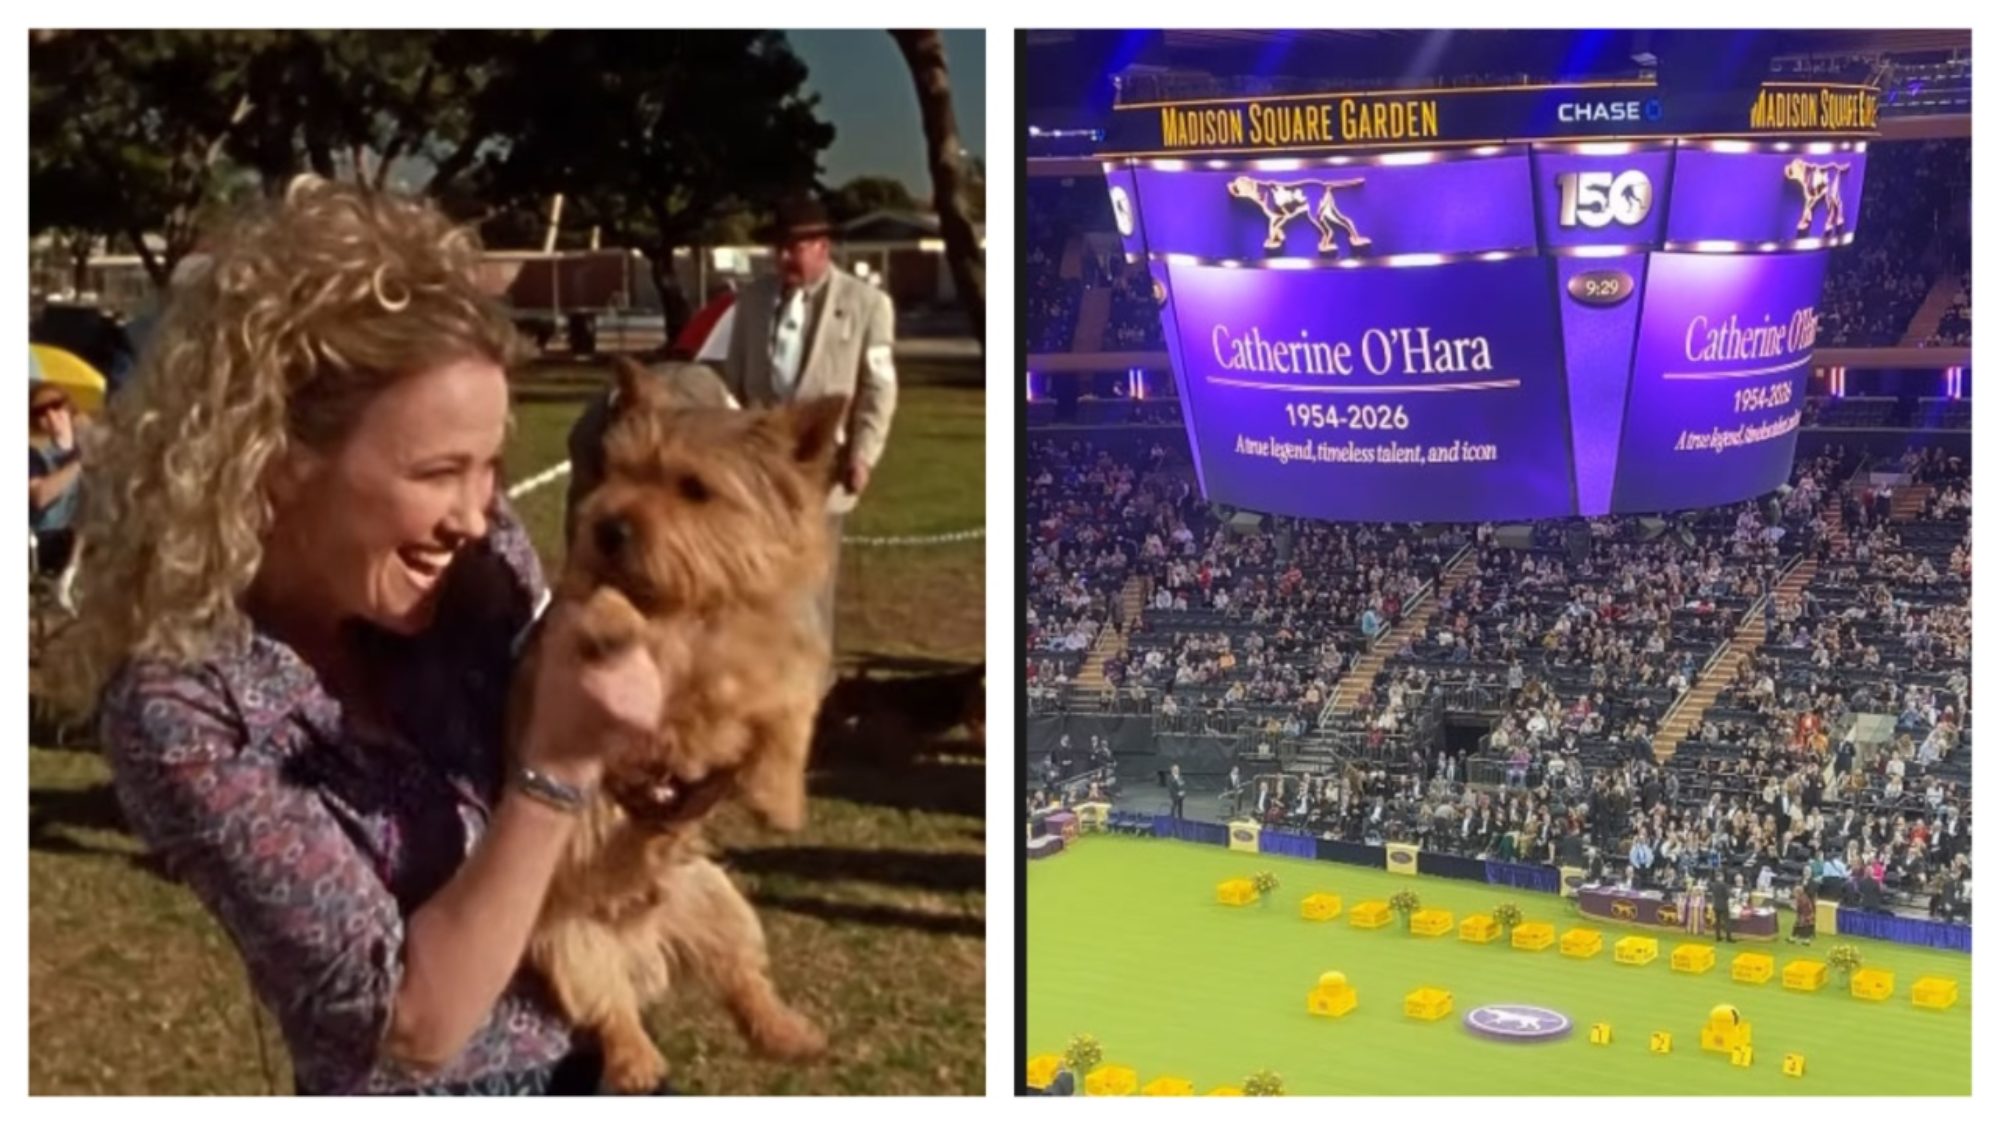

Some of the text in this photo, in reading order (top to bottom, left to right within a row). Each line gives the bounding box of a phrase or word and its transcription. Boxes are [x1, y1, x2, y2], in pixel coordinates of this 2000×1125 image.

[1161, 98, 1438, 147] MADISON SQUARE GARDEN
[1557, 101, 1640, 122] CHASE
[1750, 88, 1818, 128] MADISON
[1557, 169, 1652, 228] 150
[1585, 279, 1619, 296] 9:29
[1211, 323, 1494, 376] Catherine O’Hara
[1685, 314, 1786, 362] Catherine
[1285, 403, 1409, 430] 1954-2026
[1235, 433, 1497, 466] A true legend, timeless talent, and icon
